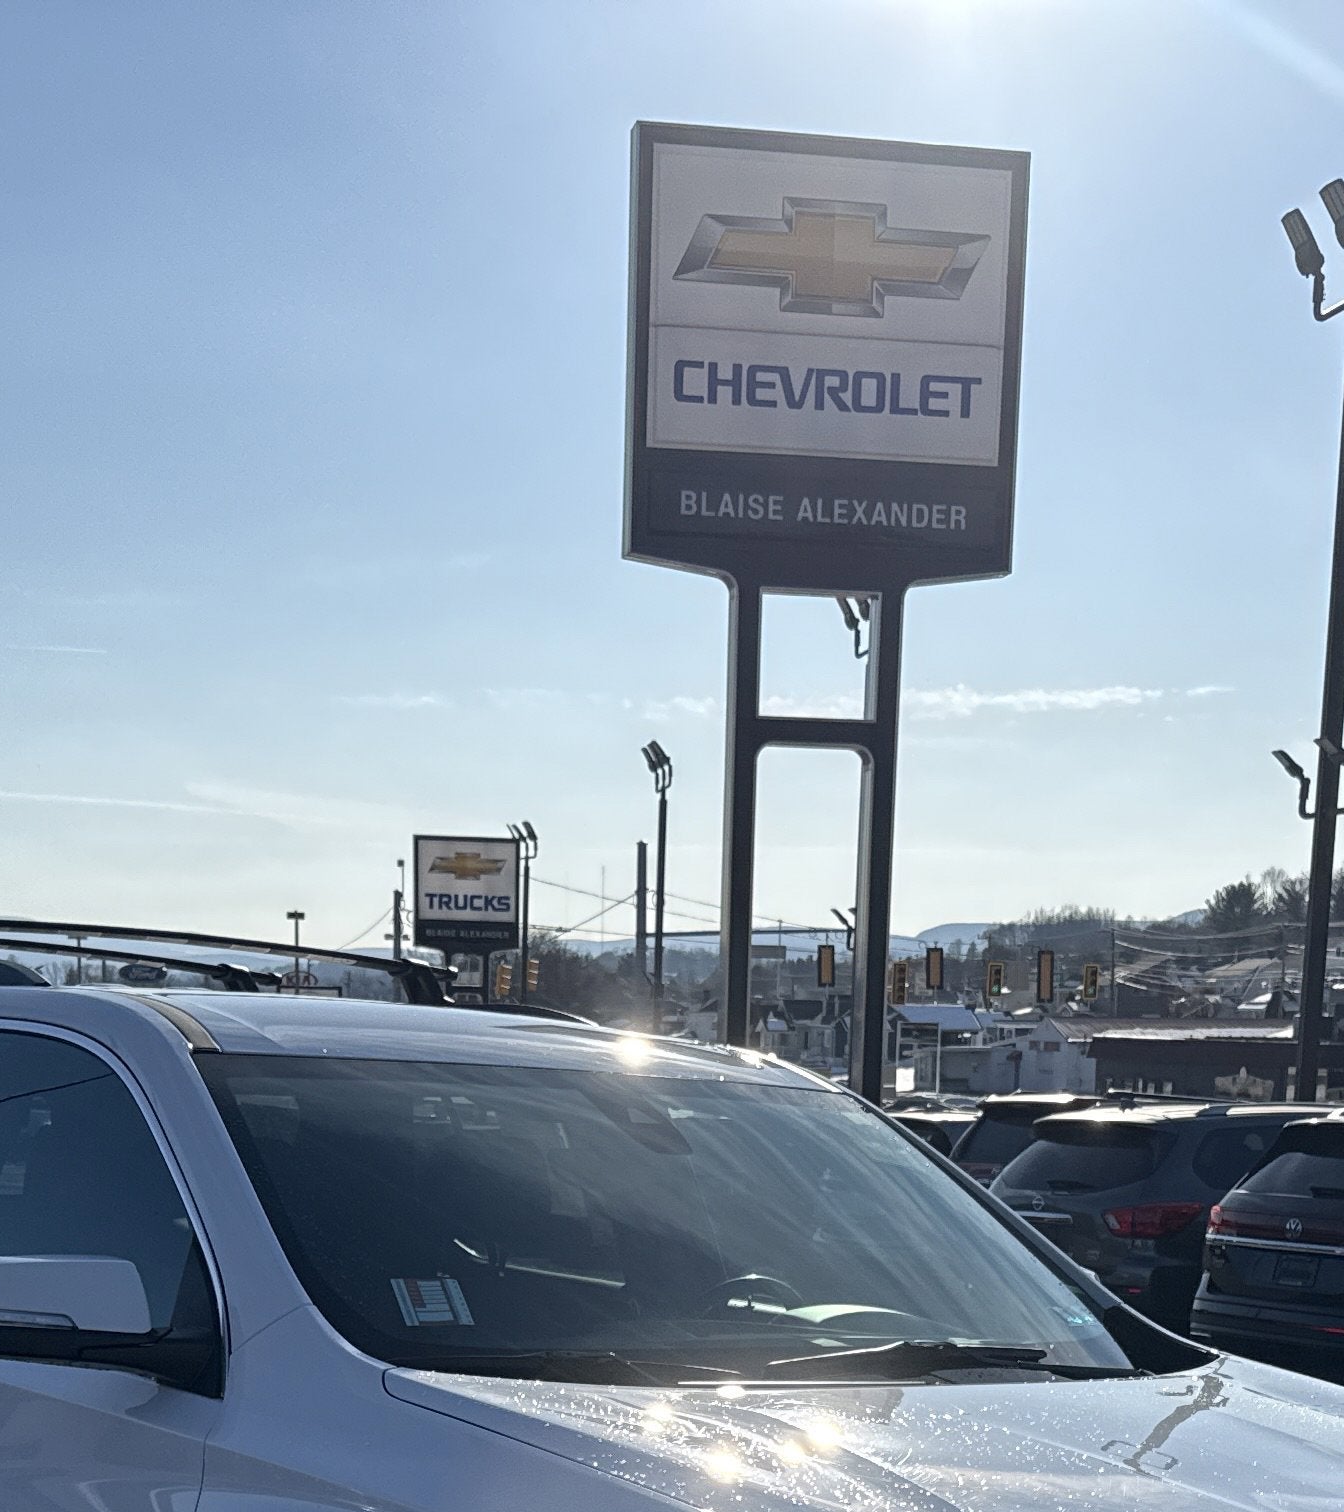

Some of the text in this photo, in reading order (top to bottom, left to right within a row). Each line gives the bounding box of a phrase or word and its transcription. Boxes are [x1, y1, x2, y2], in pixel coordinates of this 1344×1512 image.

[673, 359, 983, 419] CHEVROLET
[679, 489, 968, 531] BLAISE ALEXANDER
[424, 893, 511, 912] TRUCKS
